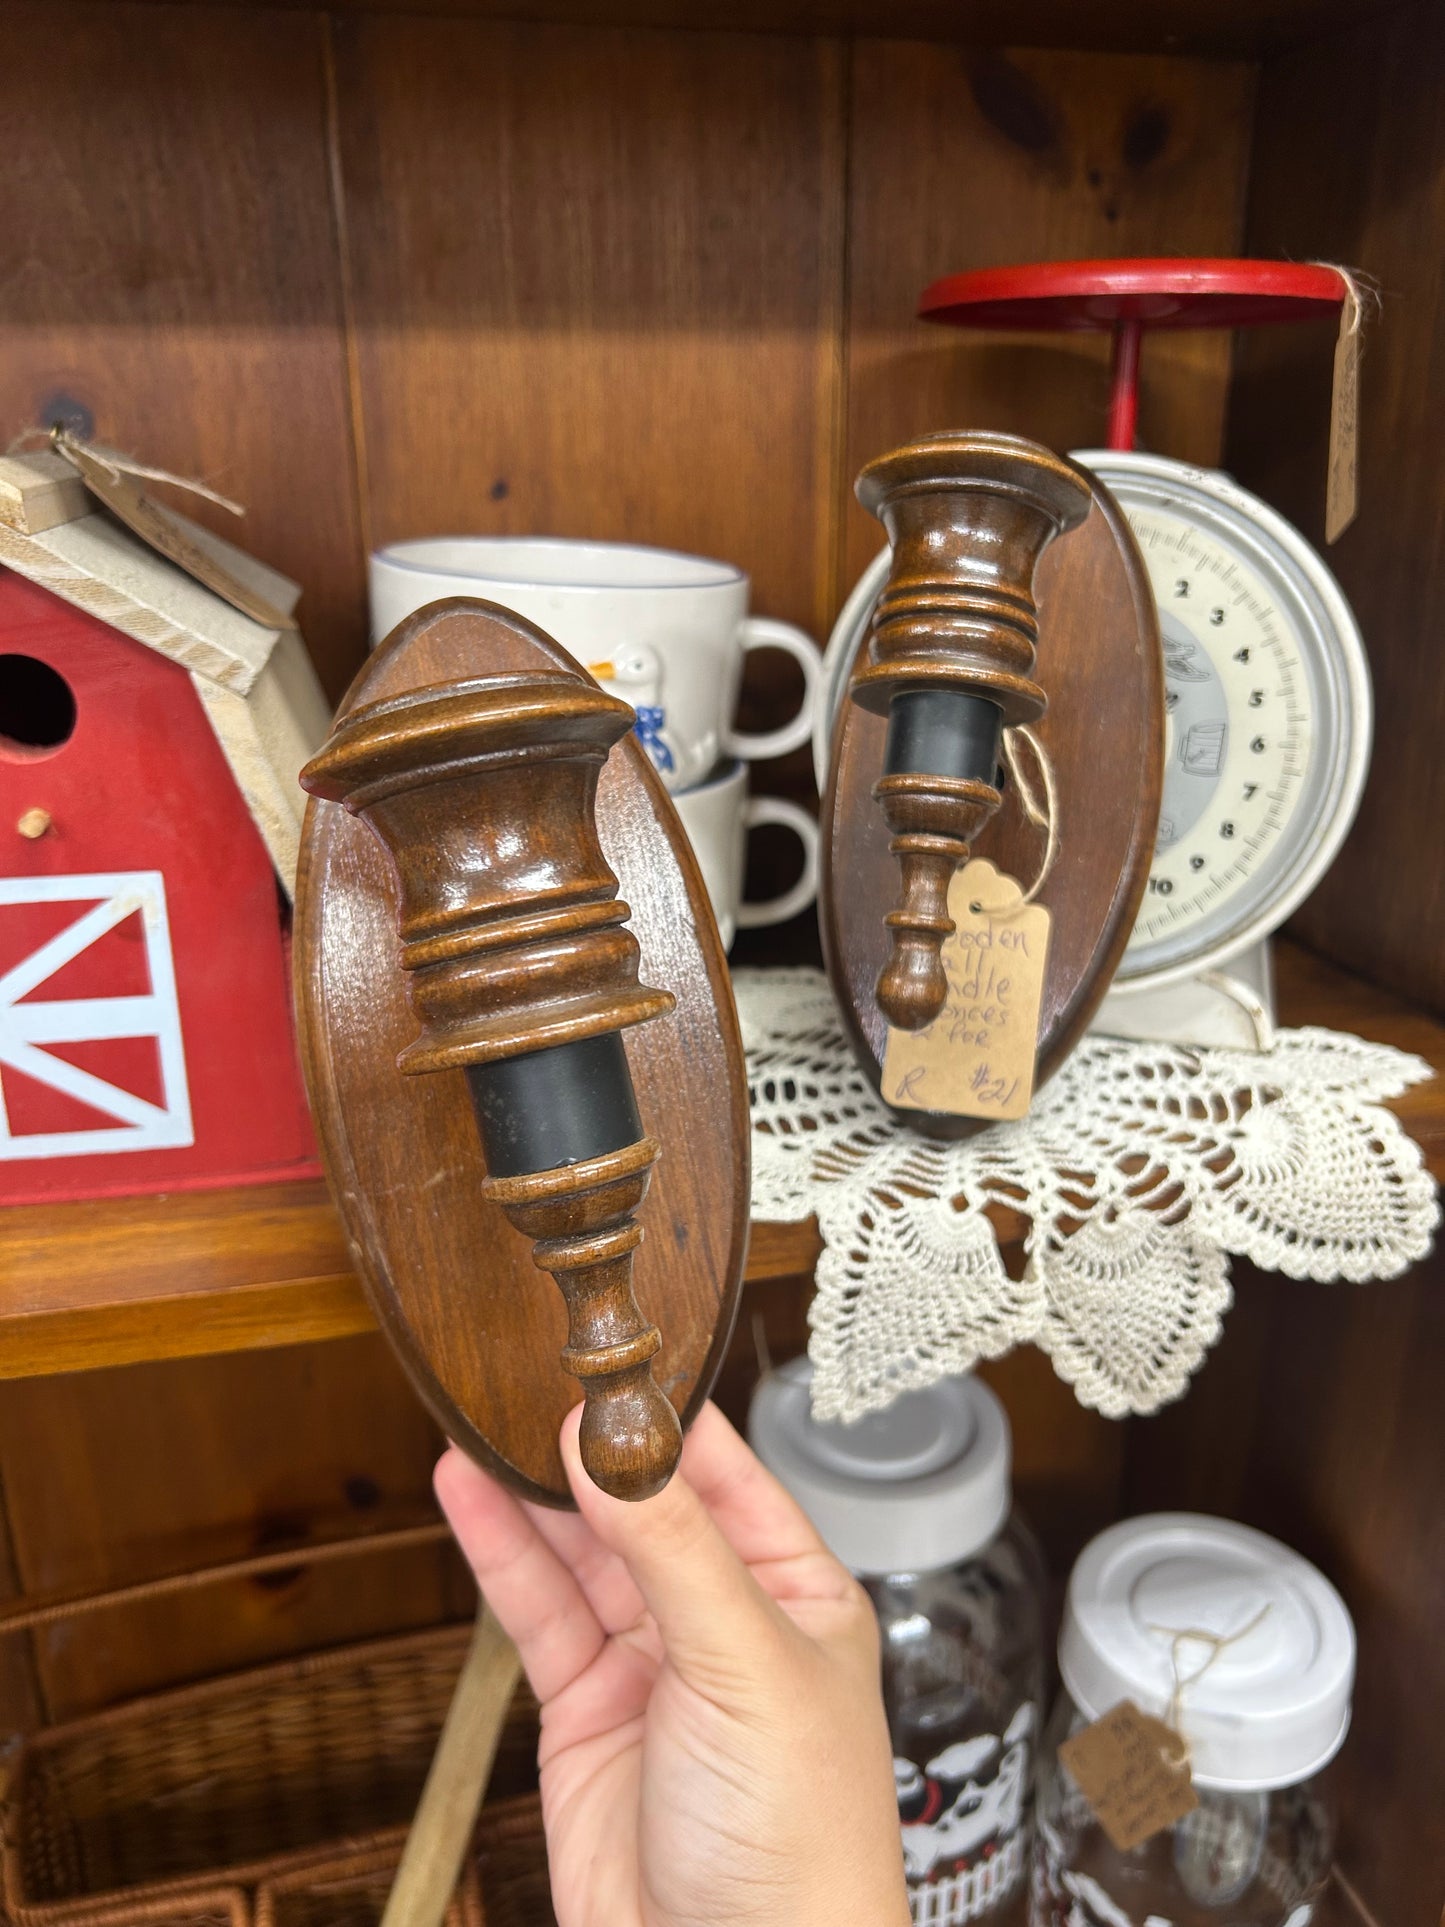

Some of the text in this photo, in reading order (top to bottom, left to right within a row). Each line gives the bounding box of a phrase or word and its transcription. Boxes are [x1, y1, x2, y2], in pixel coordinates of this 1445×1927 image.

[1174, 579, 1189, 599] 2
[1209, 607, 1224, 627] 3
[1233, 647, 1250, 665] 4
[1247, 689, 1263, 709] 5
[1250, 736, 1266, 755] 6
[1243, 781, 1259, 802] 7
[1219, 821, 1235, 841] 8
[1189, 854, 1206, 874] 9
[1149, 877, 1174, 897] 10
[941, 946, 985, 977] all
[946, 966, 1011, 1006] ndle
